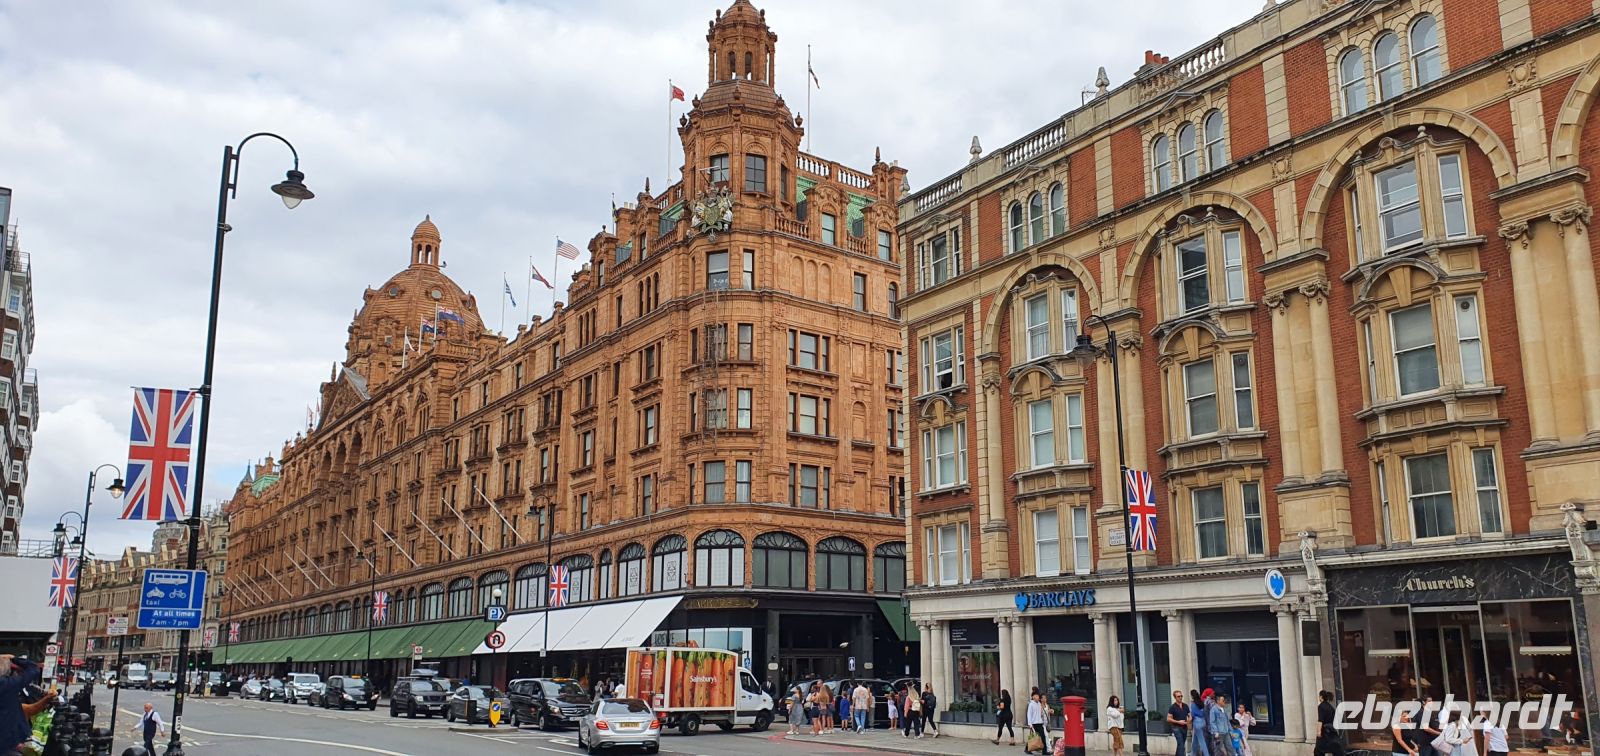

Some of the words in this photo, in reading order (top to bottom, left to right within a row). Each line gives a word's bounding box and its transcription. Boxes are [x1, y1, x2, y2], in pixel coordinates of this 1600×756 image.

[1406, 575, 1475, 592] Church's
[1029, 588, 1096, 608] BARCLAYS
[175, 610, 195, 618] times
[689, 675, 718, 684] Sainsbury's
